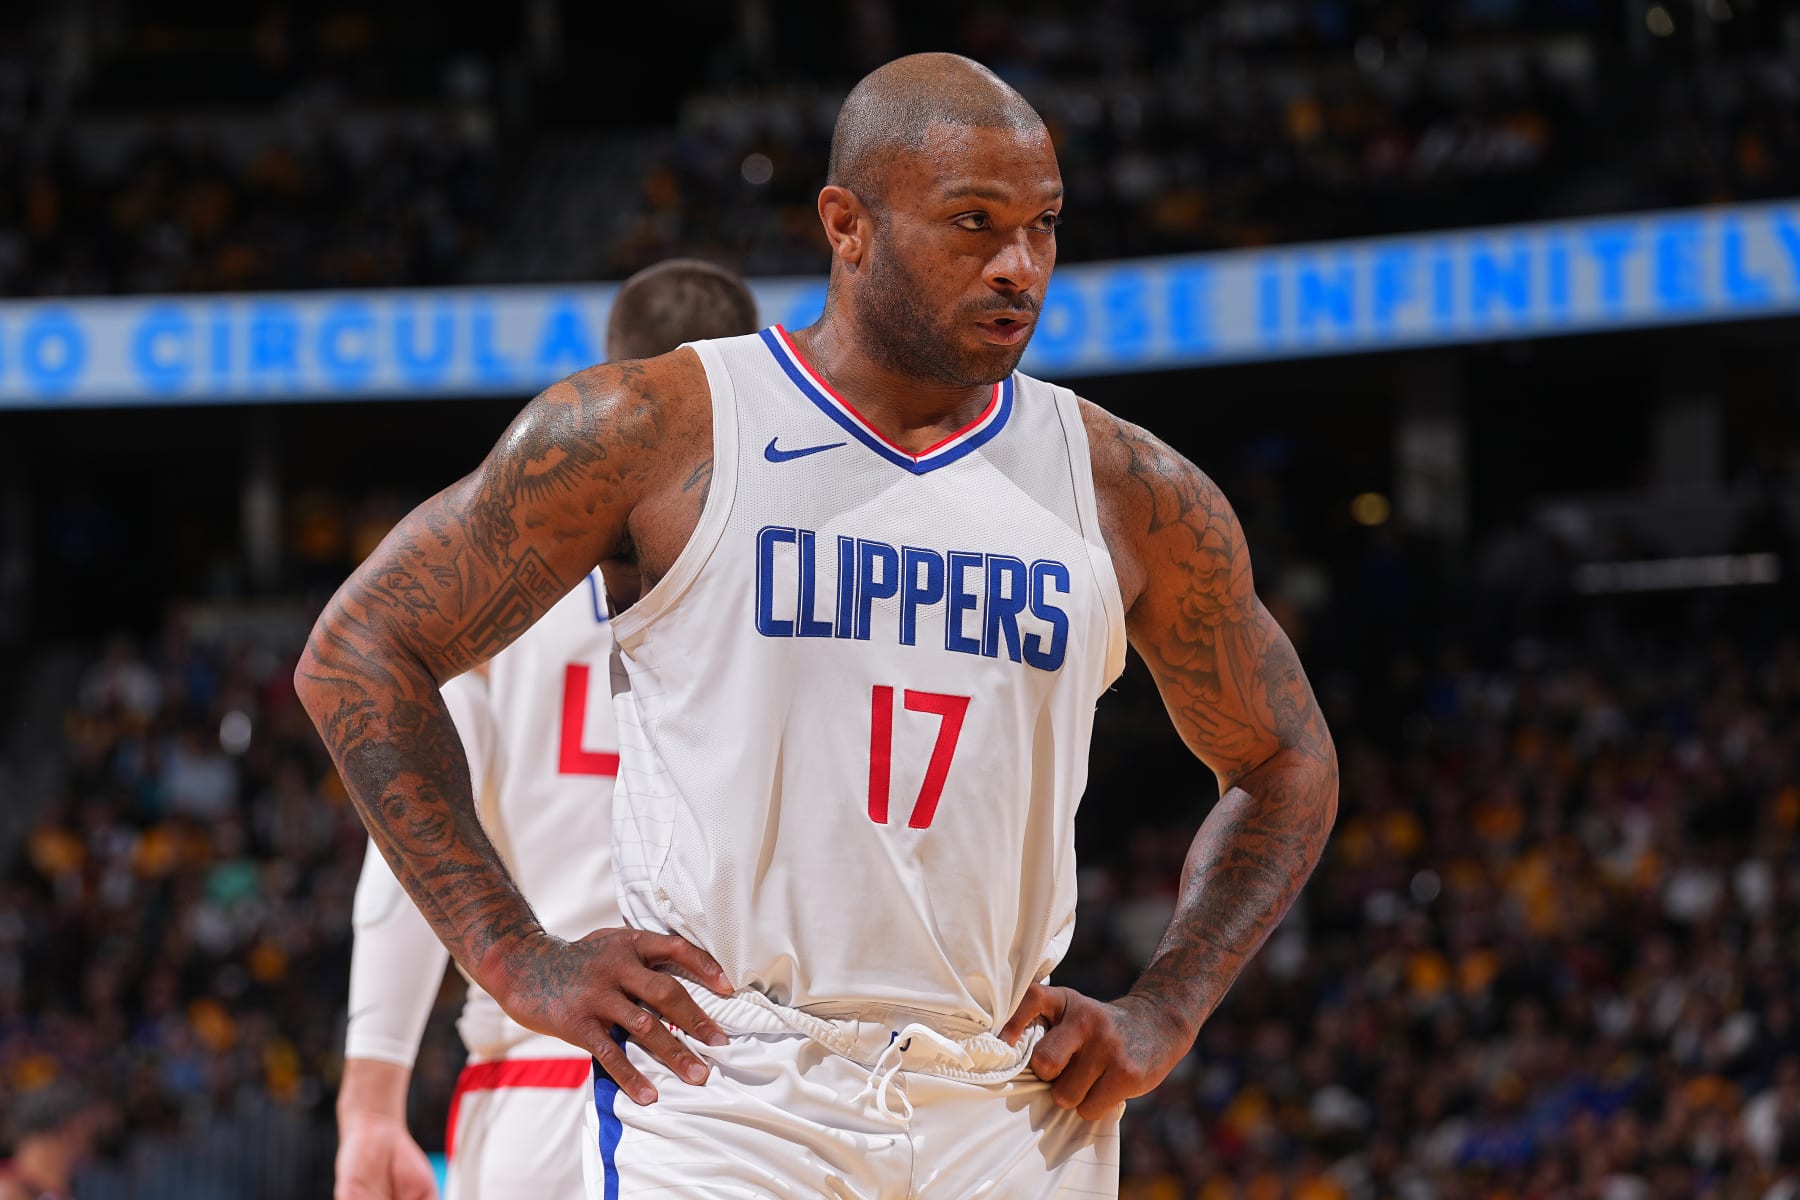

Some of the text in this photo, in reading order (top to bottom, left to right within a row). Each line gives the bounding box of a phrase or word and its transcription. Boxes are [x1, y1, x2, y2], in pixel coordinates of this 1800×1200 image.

[0, 306, 88, 397] O
[130, 291, 604, 393] CIRCULA
[520, 560, 558, 600] RUFF
[755, 525, 1071, 672] CLIPPERS
[868, 685, 972, 829] 17
